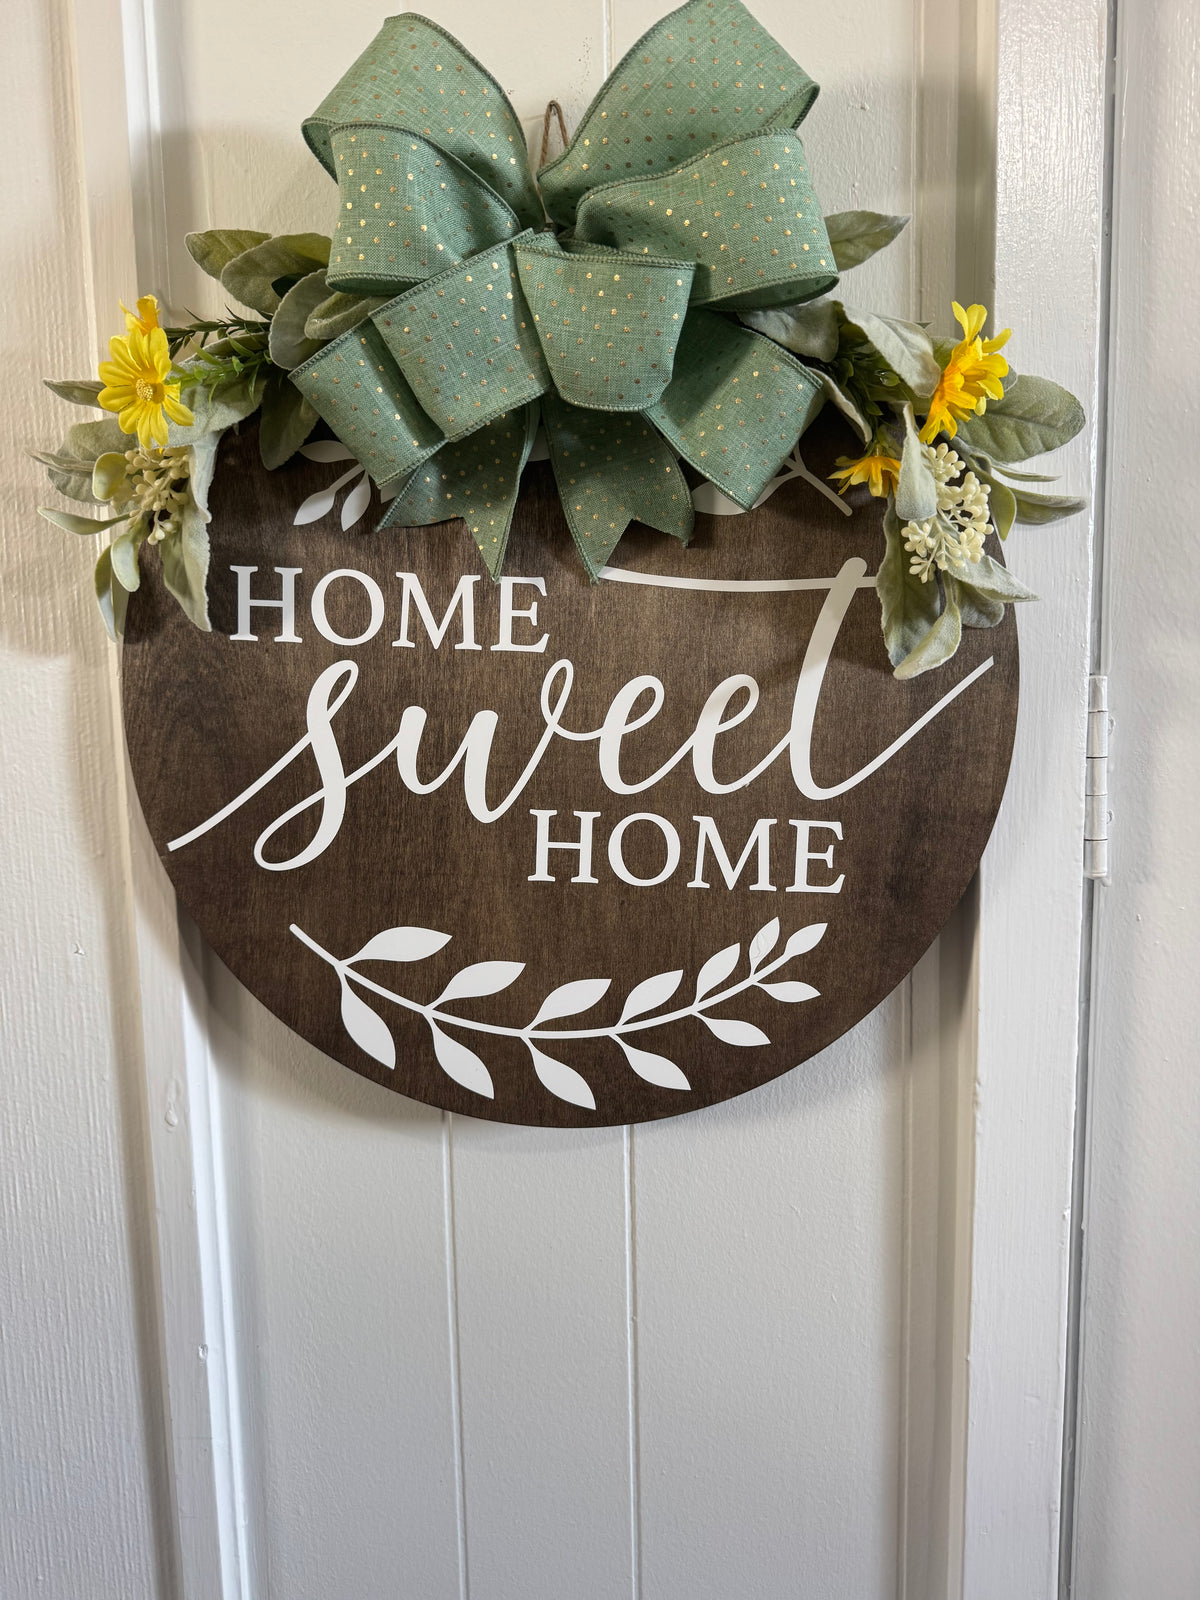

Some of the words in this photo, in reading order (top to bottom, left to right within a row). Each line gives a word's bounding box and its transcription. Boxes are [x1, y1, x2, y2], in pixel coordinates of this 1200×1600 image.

[229, 565, 551, 654] HOME
[167, 557, 994, 872] sweet
[527, 808, 846, 895] HOME
